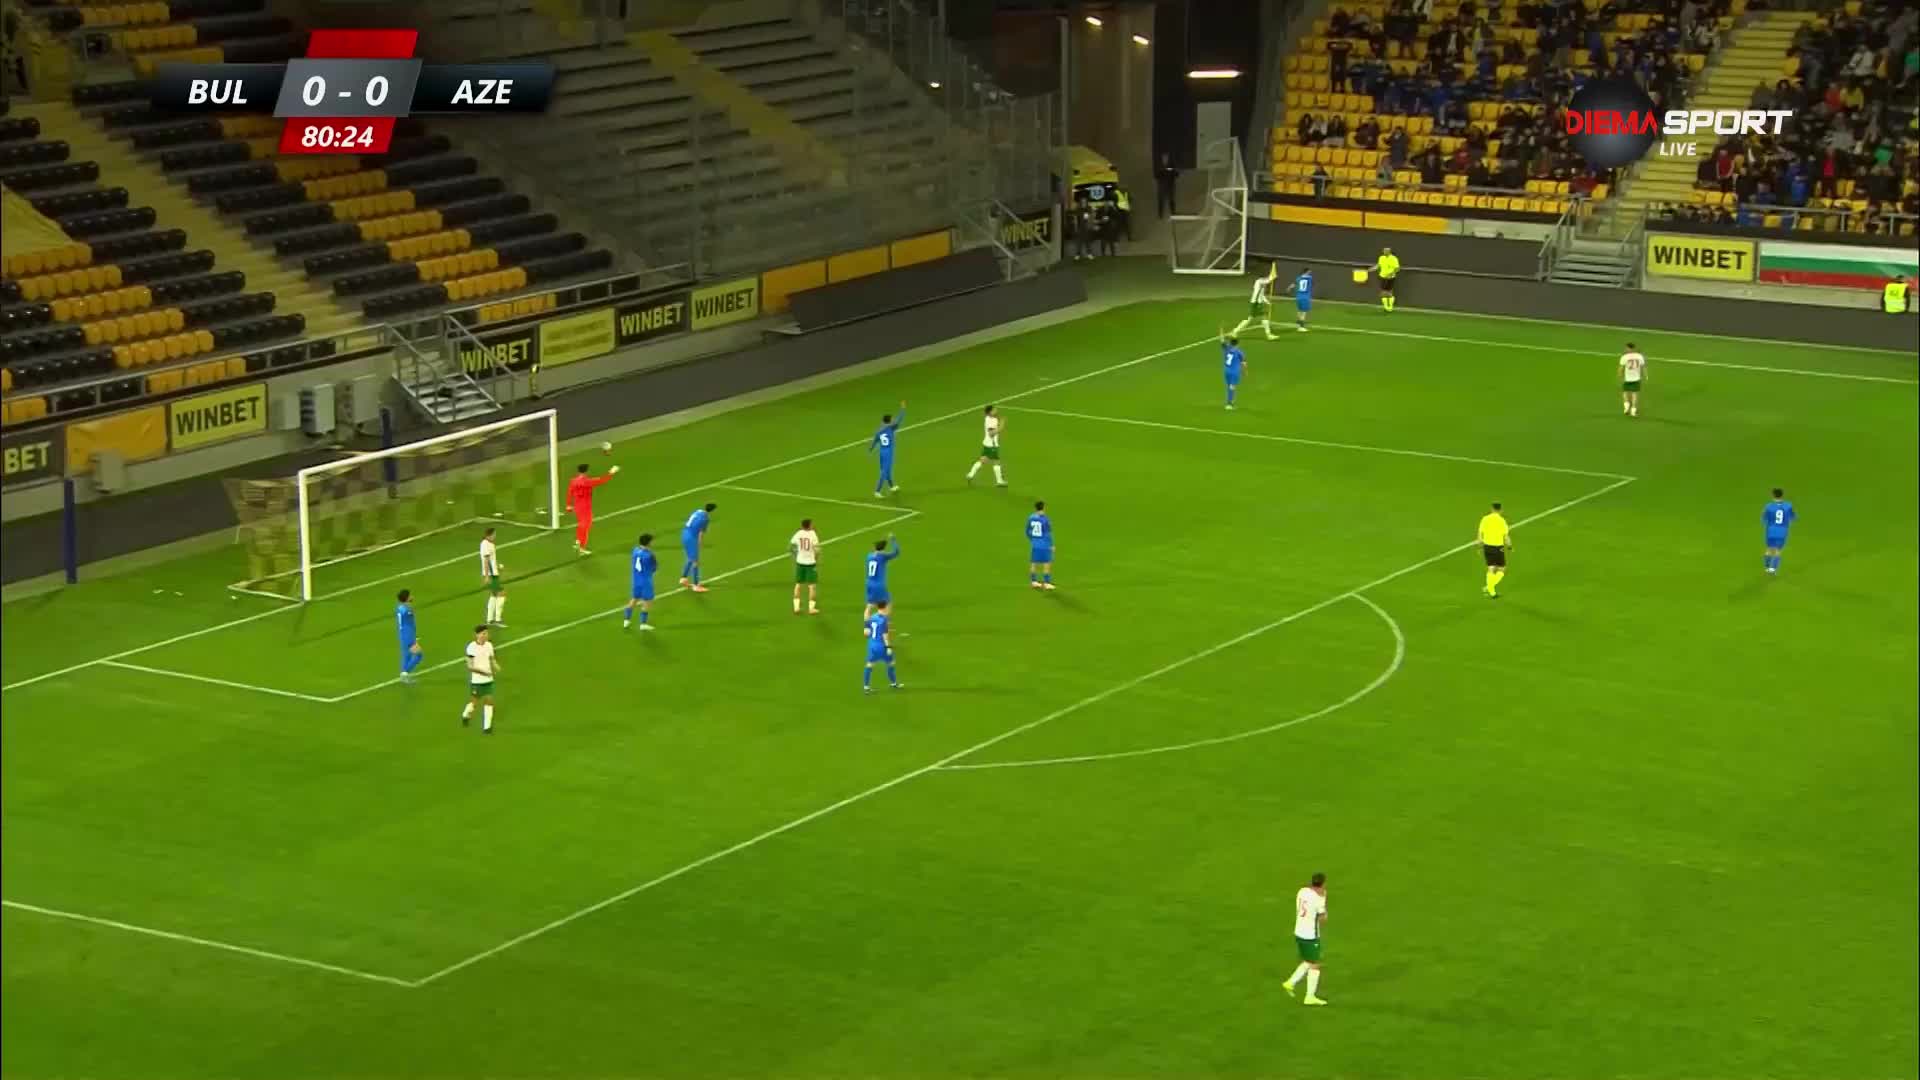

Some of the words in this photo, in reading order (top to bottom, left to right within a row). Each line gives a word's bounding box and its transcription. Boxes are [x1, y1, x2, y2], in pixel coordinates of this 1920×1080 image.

[1653, 246, 1748, 270] WINBET
[694, 289, 755, 319] WINBET
[620, 302, 683, 336] WINBET
[460, 339, 531, 372] WINBET
[175, 396, 260, 436] WINBET
[1775, 509, 1784, 525] 9
[799, 537, 811, 551] 10
[634, 556, 642, 572] 4
